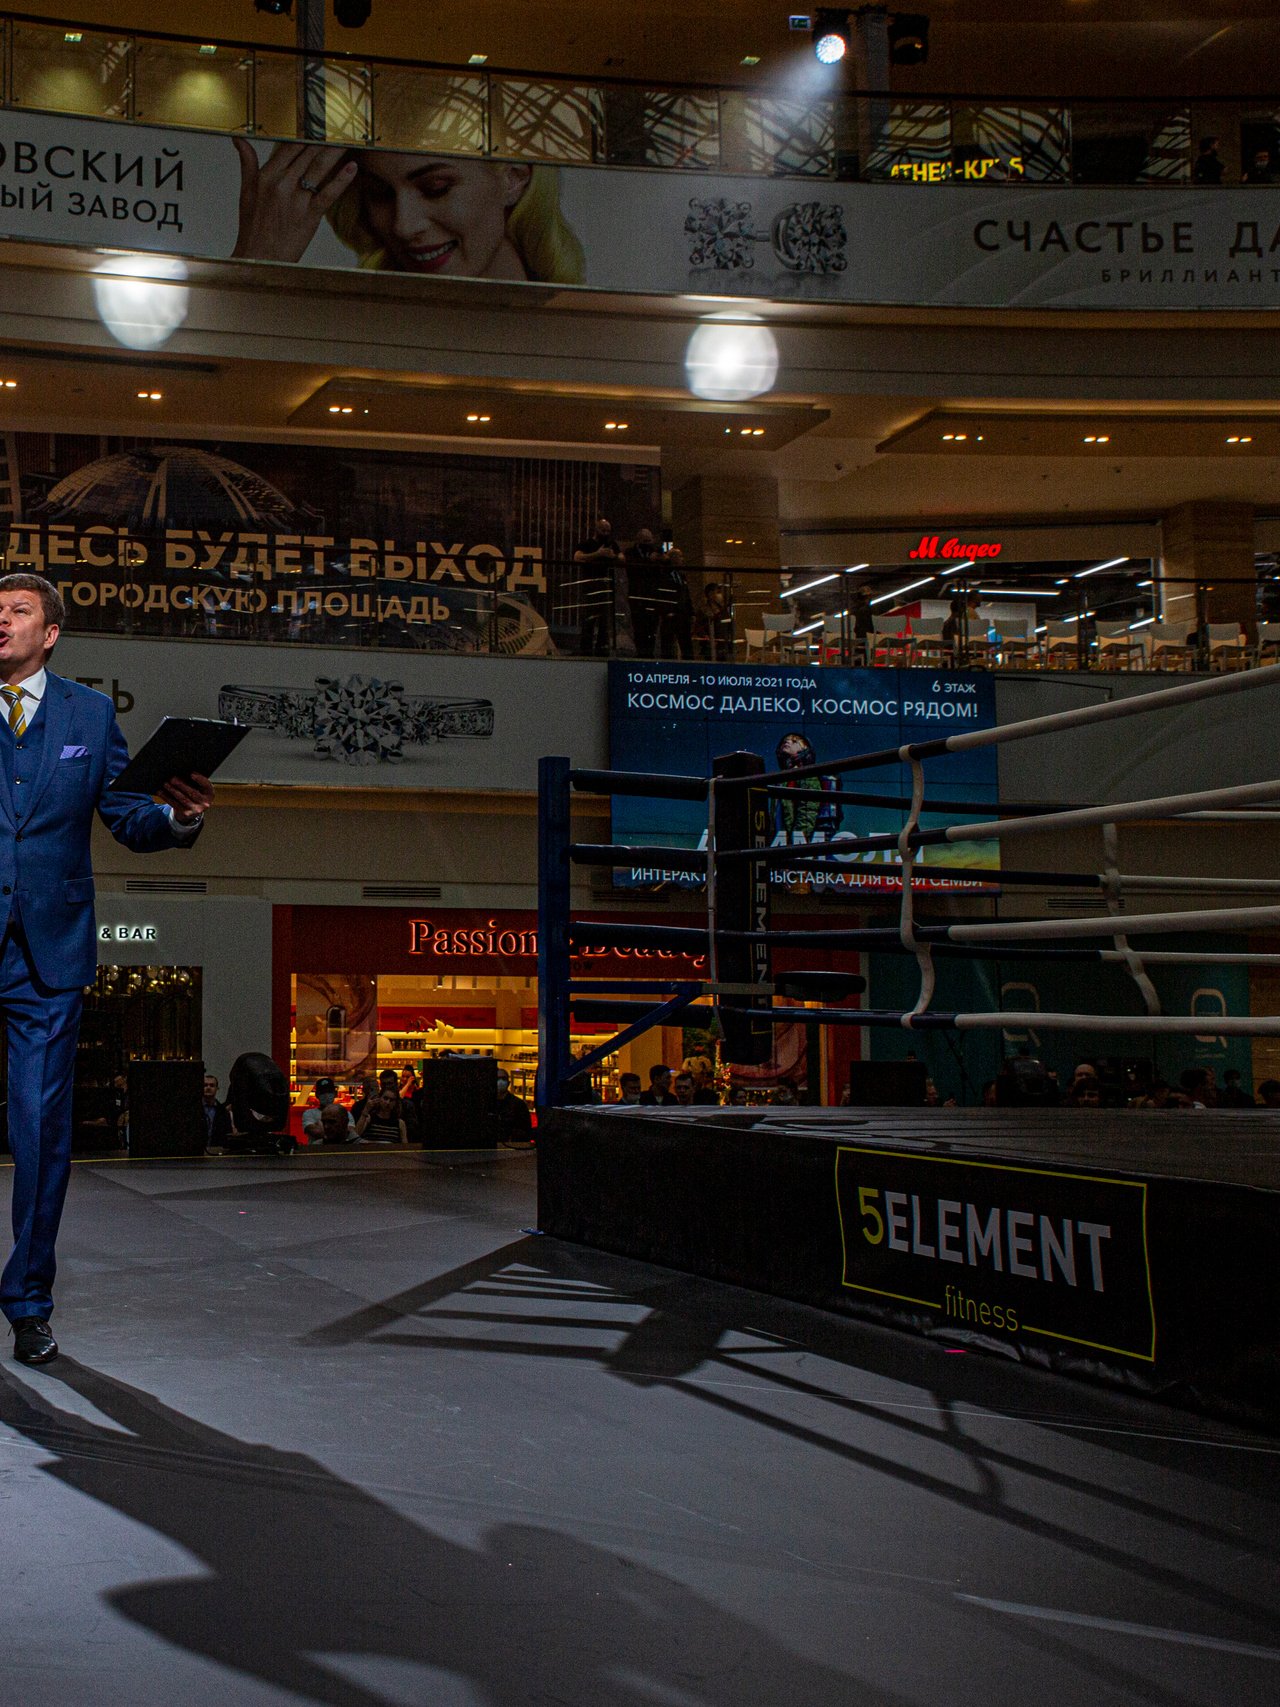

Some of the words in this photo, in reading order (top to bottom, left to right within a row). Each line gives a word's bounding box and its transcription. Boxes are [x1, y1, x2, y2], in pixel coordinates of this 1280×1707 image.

[67, 192, 184, 233] ЗАВОД
[973, 219, 1195, 254] СЧАСТЬЕ
[165, 529, 336, 581] БУДЕТ
[349, 537, 547, 594] ВЫХОД
[58, 579, 268, 615] ГОРОДСКУЮ
[277, 590, 451, 625] ПЛОЩАДЬ
[645, 674, 690, 685] АПРЕЛЯ
[718, 676, 754, 688] ИЮЛЯ
[755, 677, 783, 688] 2021
[786, 678, 818, 690] ГОДА
[932, 680, 942, 693] 6
[944, 682, 977, 694] ЭТАЖ
[627, 692, 716, 711] КОСМОС
[719, 695, 806, 716] ДАЛЕКО,
[812, 699, 899, 717] КОСМОС
[903, 701, 980, 720] РЯДОМ!
[849, 873, 883, 887] ДЛЯ
[119, 927, 157, 940] BAR
[408, 918, 538, 955] Passion
[857, 1186, 1112, 1293] 5ELEMENT
[944, 1284, 1019, 1332] fitness
